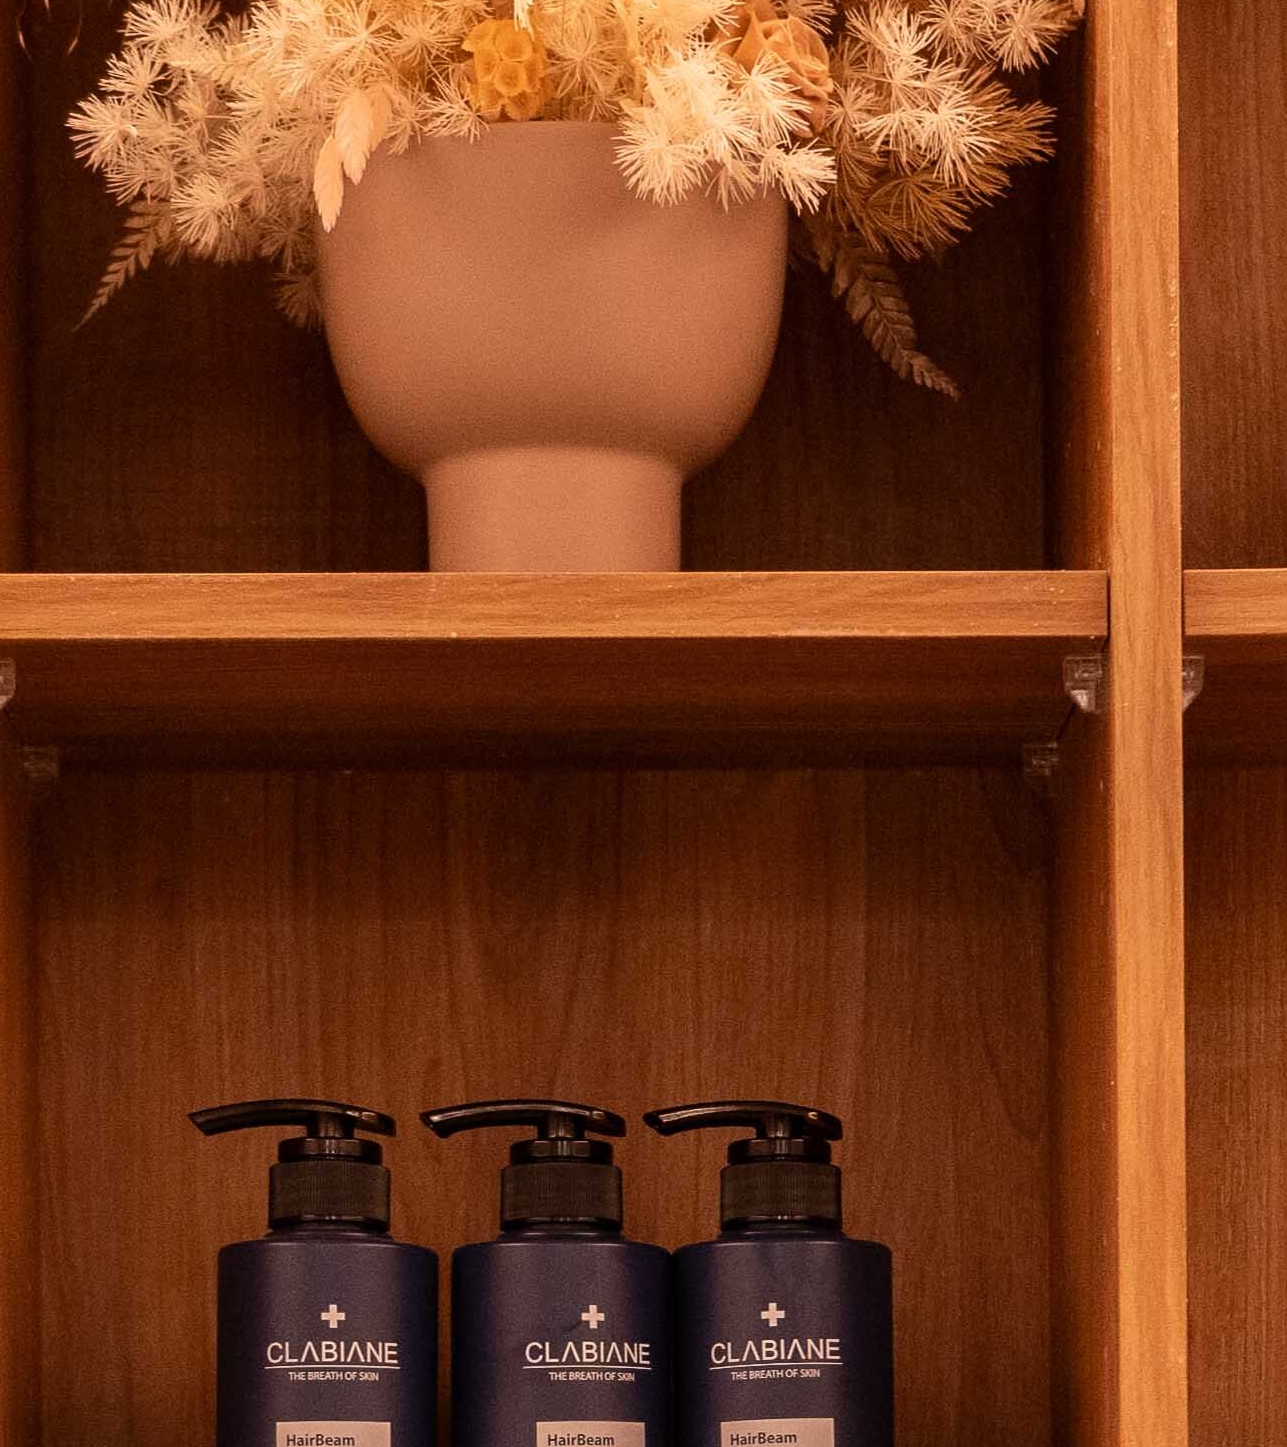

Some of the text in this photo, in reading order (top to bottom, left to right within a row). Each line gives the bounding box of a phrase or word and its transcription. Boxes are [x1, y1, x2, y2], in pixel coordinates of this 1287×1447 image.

[266, 1340, 398, 1364] CLABIANE
[525, 1340, 651, 1365] CLABIANE
[711, 1338, 841, 1364] CLABIANE
[287, 1371, 379, 1381] THE BREATH OF SKIN
[548, 1371, 635, 1382] THE BREATH OF SKIN
[730, 1368, 821, 1381] THE BREATH OF SKIN
[286, 1433, 355, 1447] HairBeam
[547, 1433, 615, 1447] HairBeam
[730, 1431, 798, 1446] HairBeam
